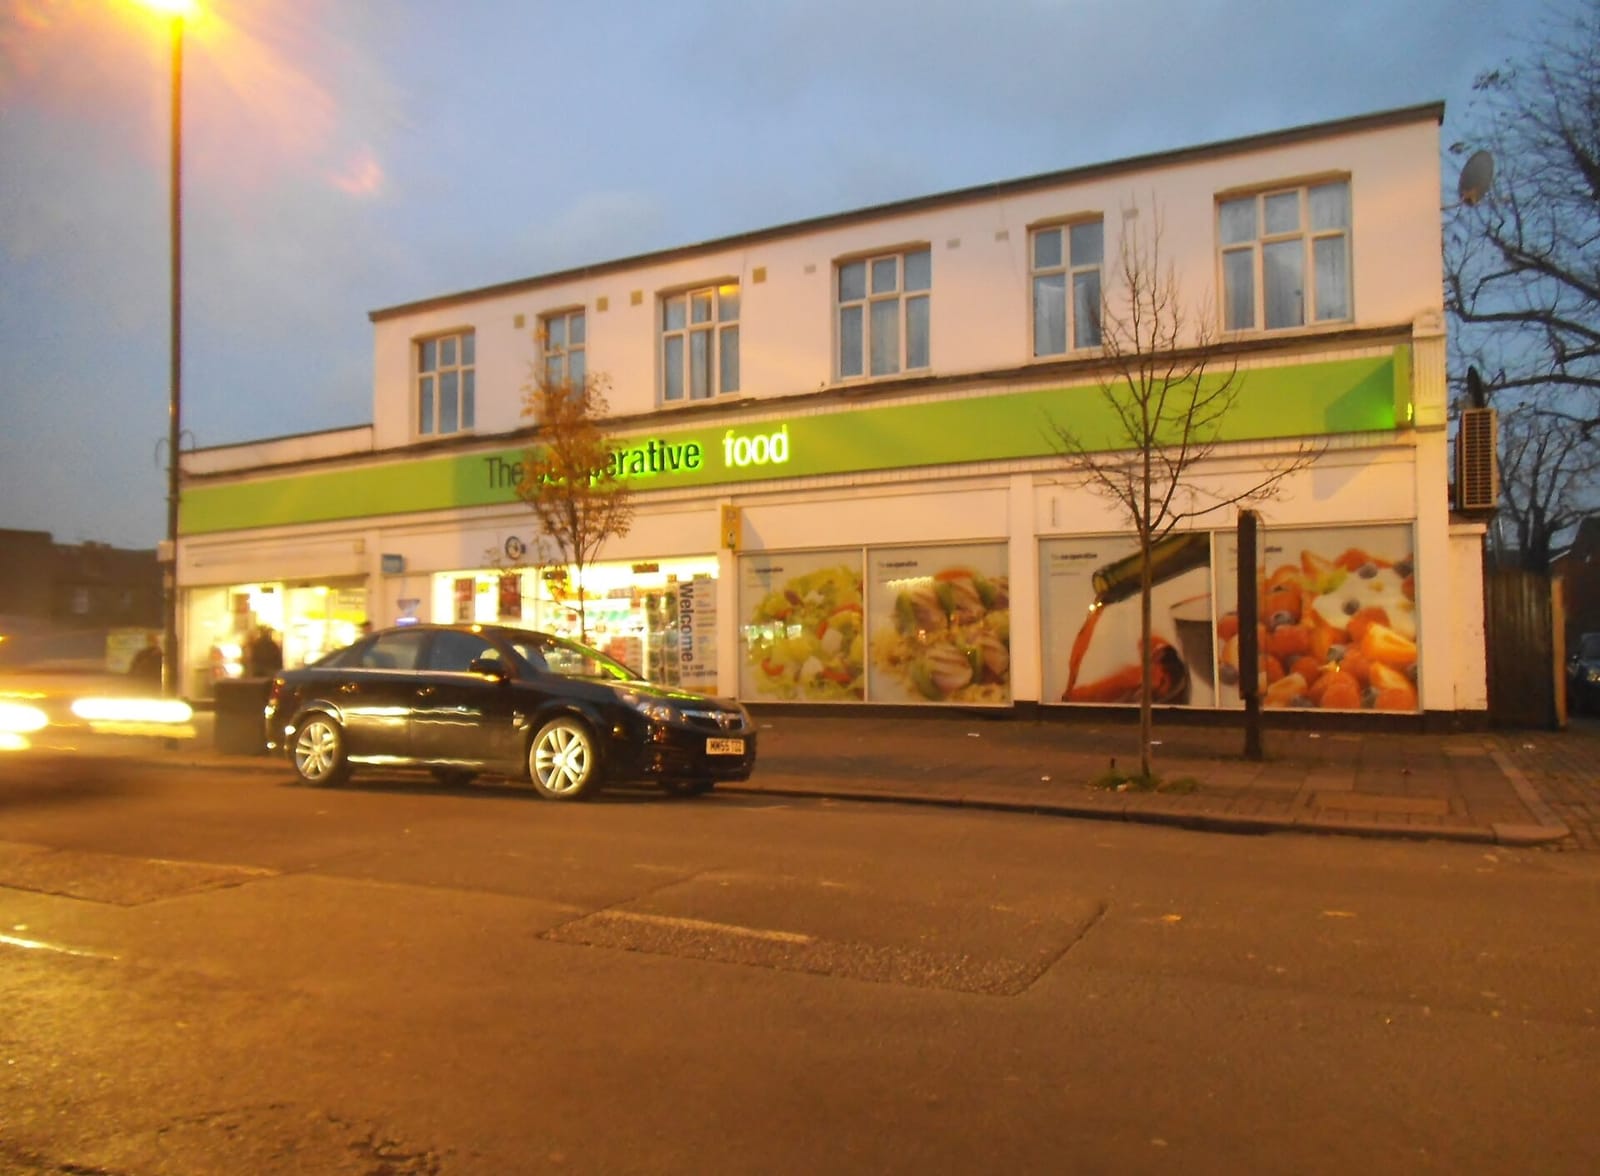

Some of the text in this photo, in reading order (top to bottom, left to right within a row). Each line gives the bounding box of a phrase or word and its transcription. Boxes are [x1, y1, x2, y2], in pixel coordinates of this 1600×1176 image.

[484, 424, 789, 489] The erative food
[679, 582, 694, 662] Welcome
